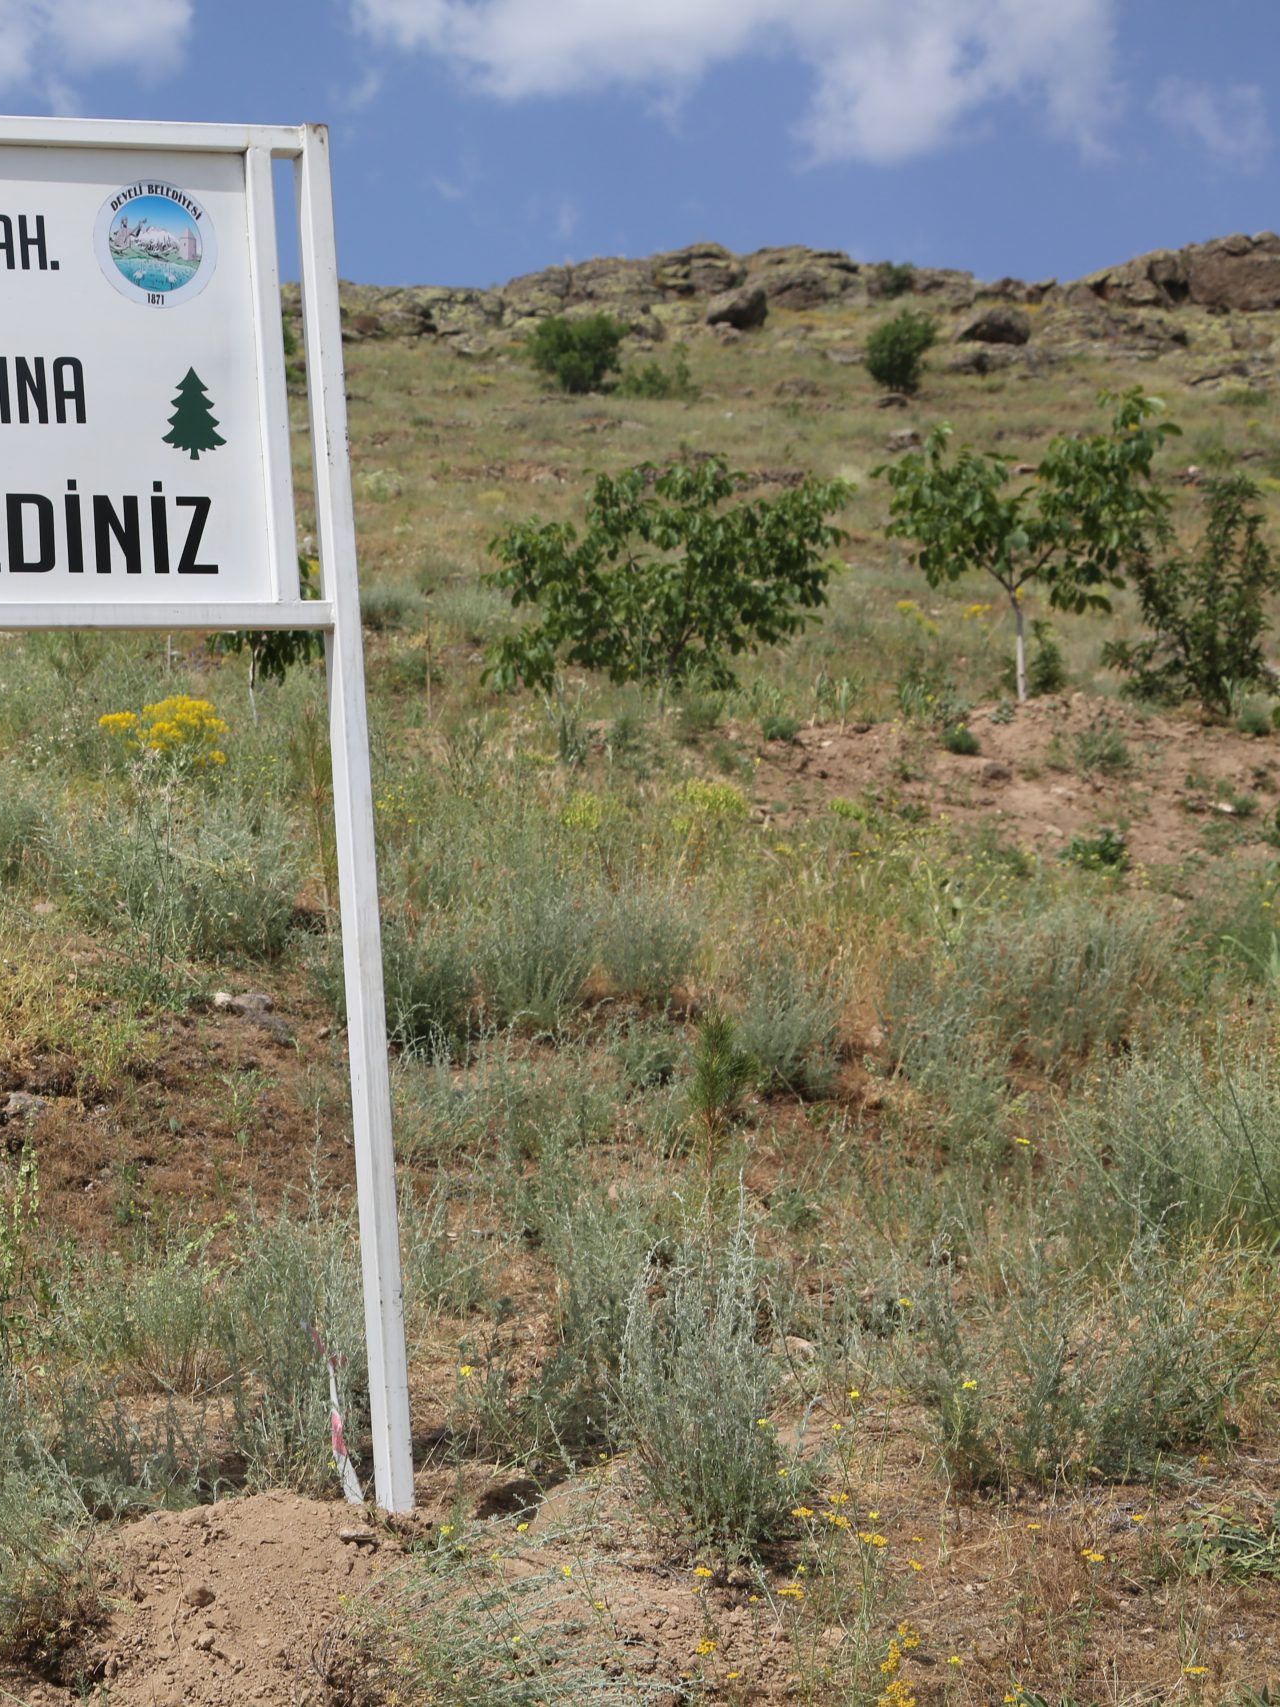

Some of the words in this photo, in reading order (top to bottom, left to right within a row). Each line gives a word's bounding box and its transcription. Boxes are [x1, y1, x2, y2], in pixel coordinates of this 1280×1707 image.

[110, 183, 143, 212] DEVELİ
[147, 184, 203, 221] BELEDİYESİ
[147, 292, 165, 305] 1871
